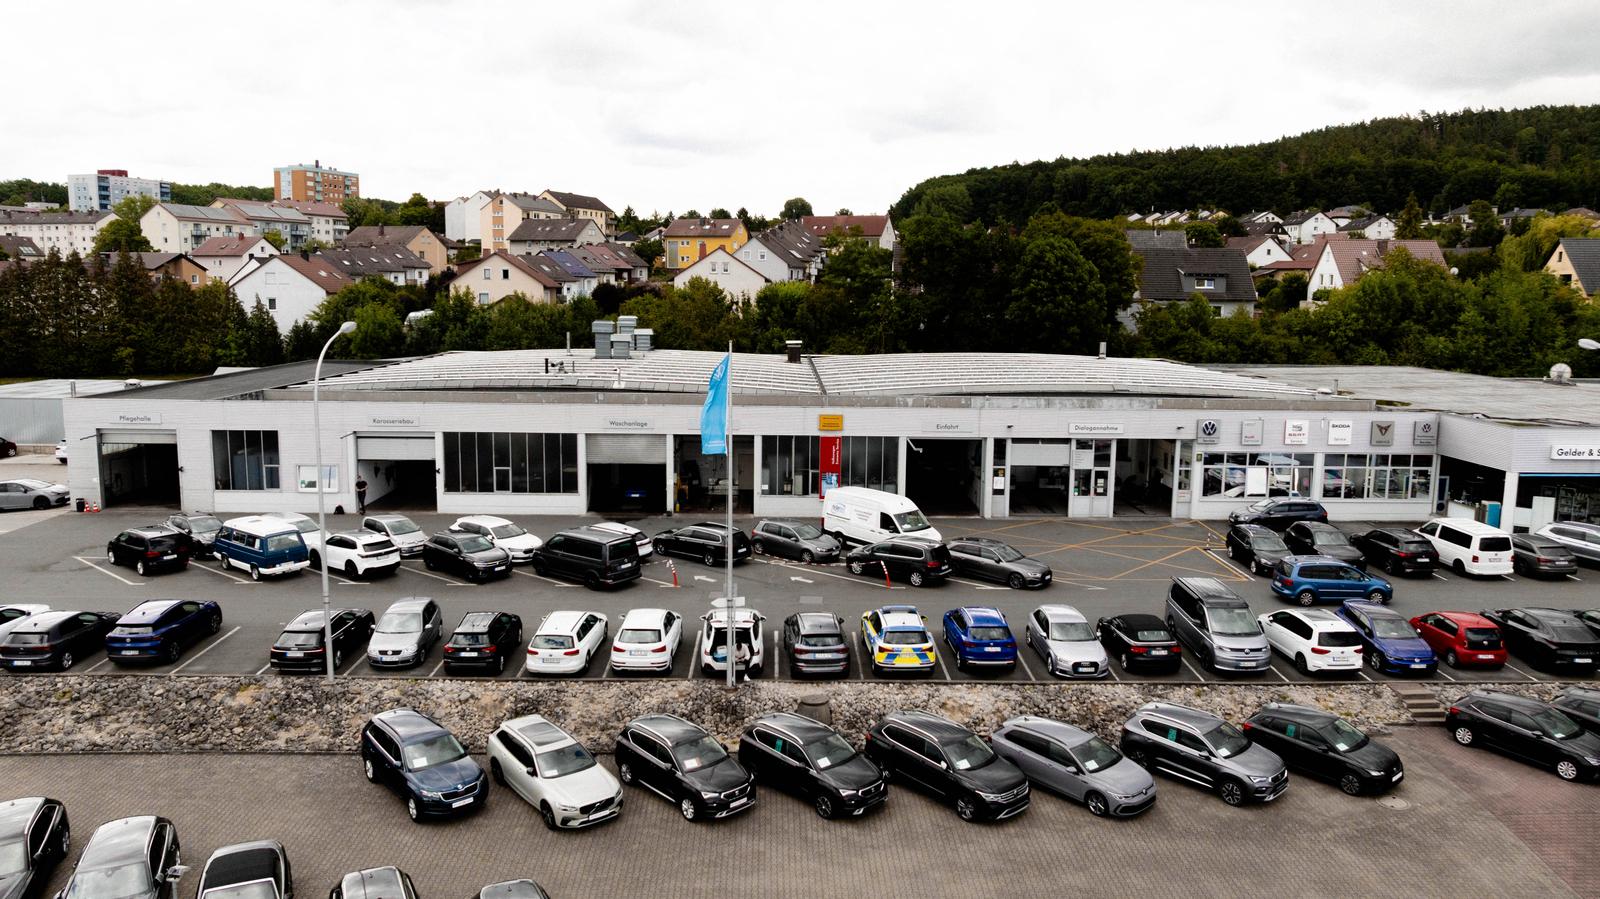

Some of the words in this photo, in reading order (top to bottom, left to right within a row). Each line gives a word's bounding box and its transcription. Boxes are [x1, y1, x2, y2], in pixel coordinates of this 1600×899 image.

[119, 415, 151, 423] Pflegehalle
[1556, 448, 1585, 457] Gelder
[1588, 448, 1594, 457] &
